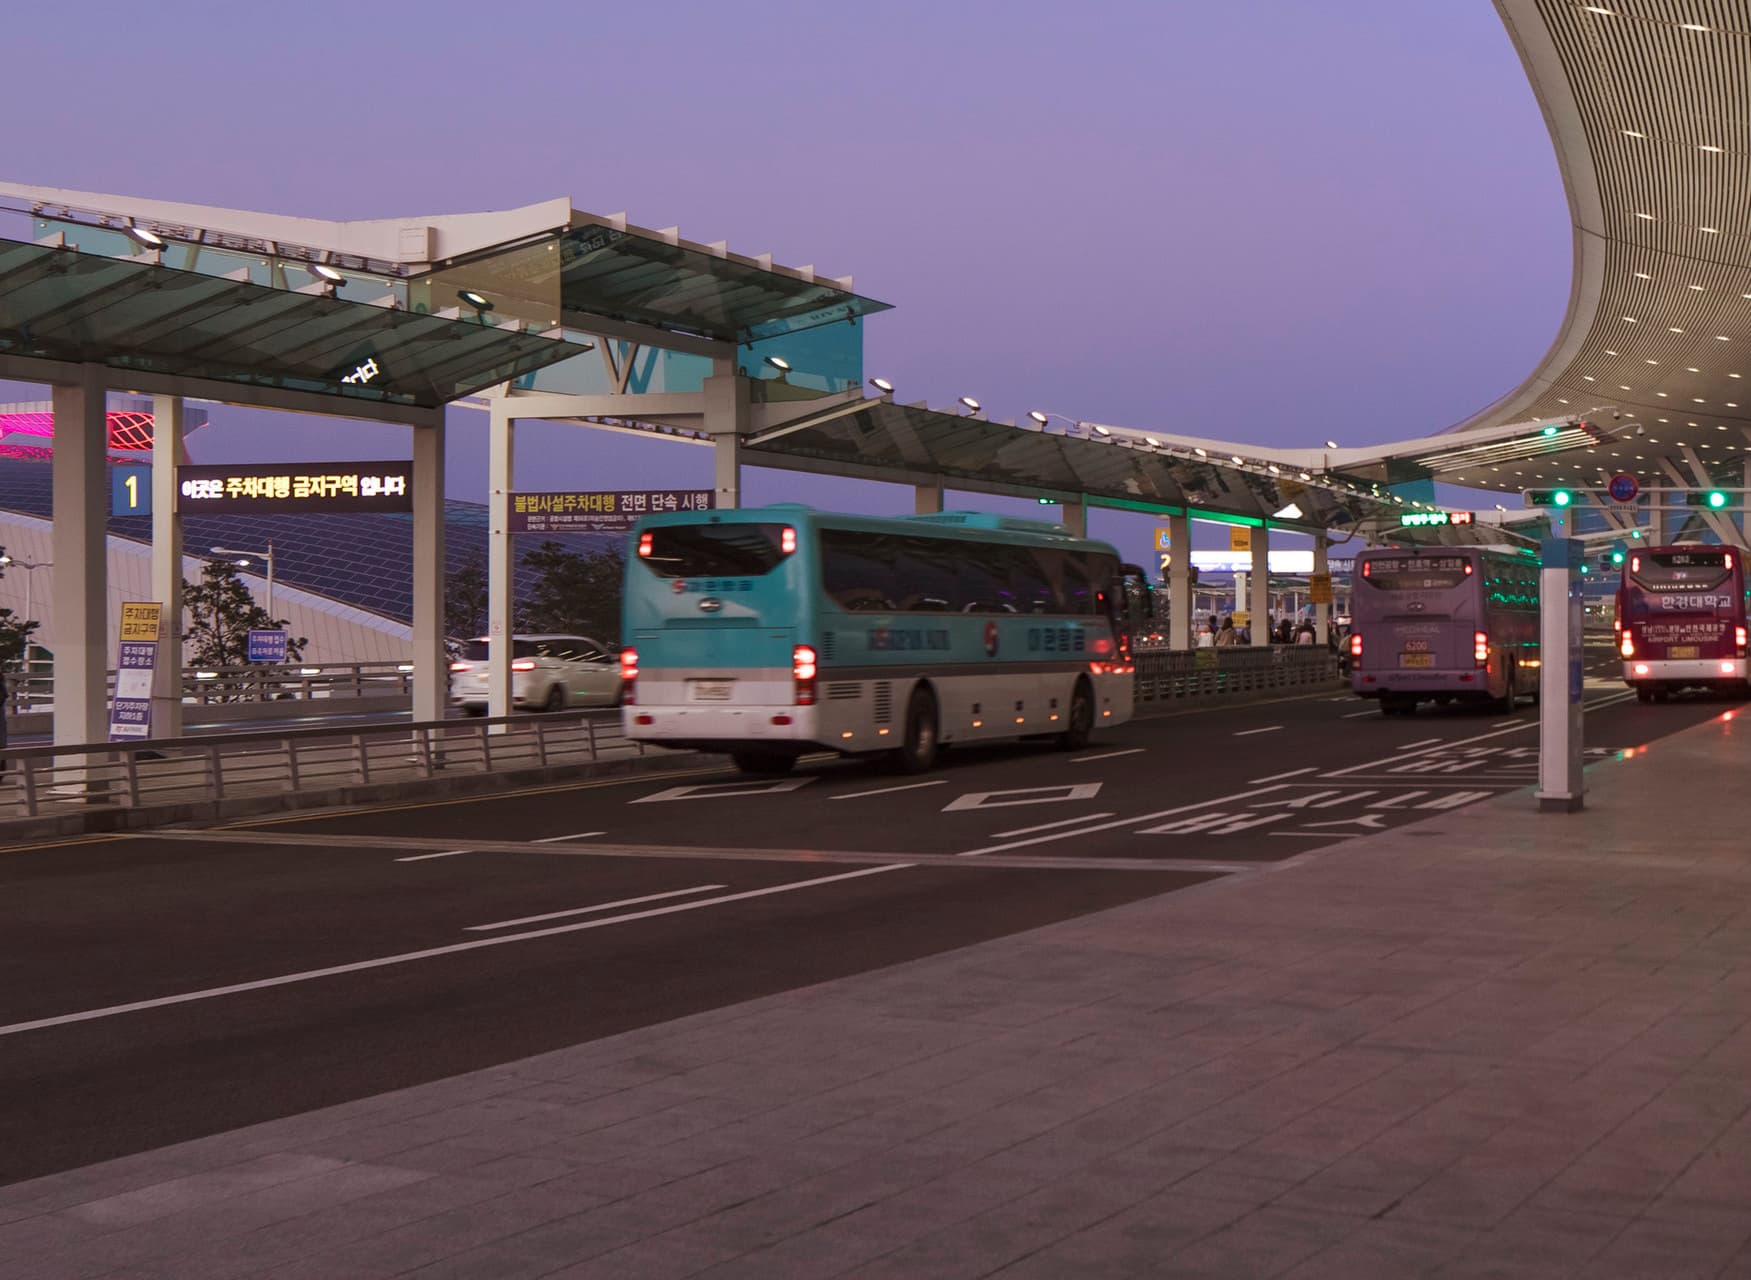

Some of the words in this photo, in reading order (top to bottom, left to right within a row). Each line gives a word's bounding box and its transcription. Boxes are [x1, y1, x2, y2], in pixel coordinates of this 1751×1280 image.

[125, 475, 137, 508] 1
[181, 479, 224, 499] 이곳은
[226, 476, 290, 498] 주차대행
[293, 475, 358, 498] 금지구역
[360, 475, 405, 497] 입니다
[514, 495, 615, 513] 불법사설주차대행
[621, 494, 647, 512] 전면
[651, 494, 678, 511] 단속
[682, 493, 709, 511] 시행
[124, 607, 160, 620] 주차대행
[123, 623, 158, 636] 금지구역
[123, 646, 153, 657] 주차대행
[1406, 640, 1427, 651] 6200
[115, 701, 149, 712] 단기주차장
[1134, 813, 1386, 838] 버스
